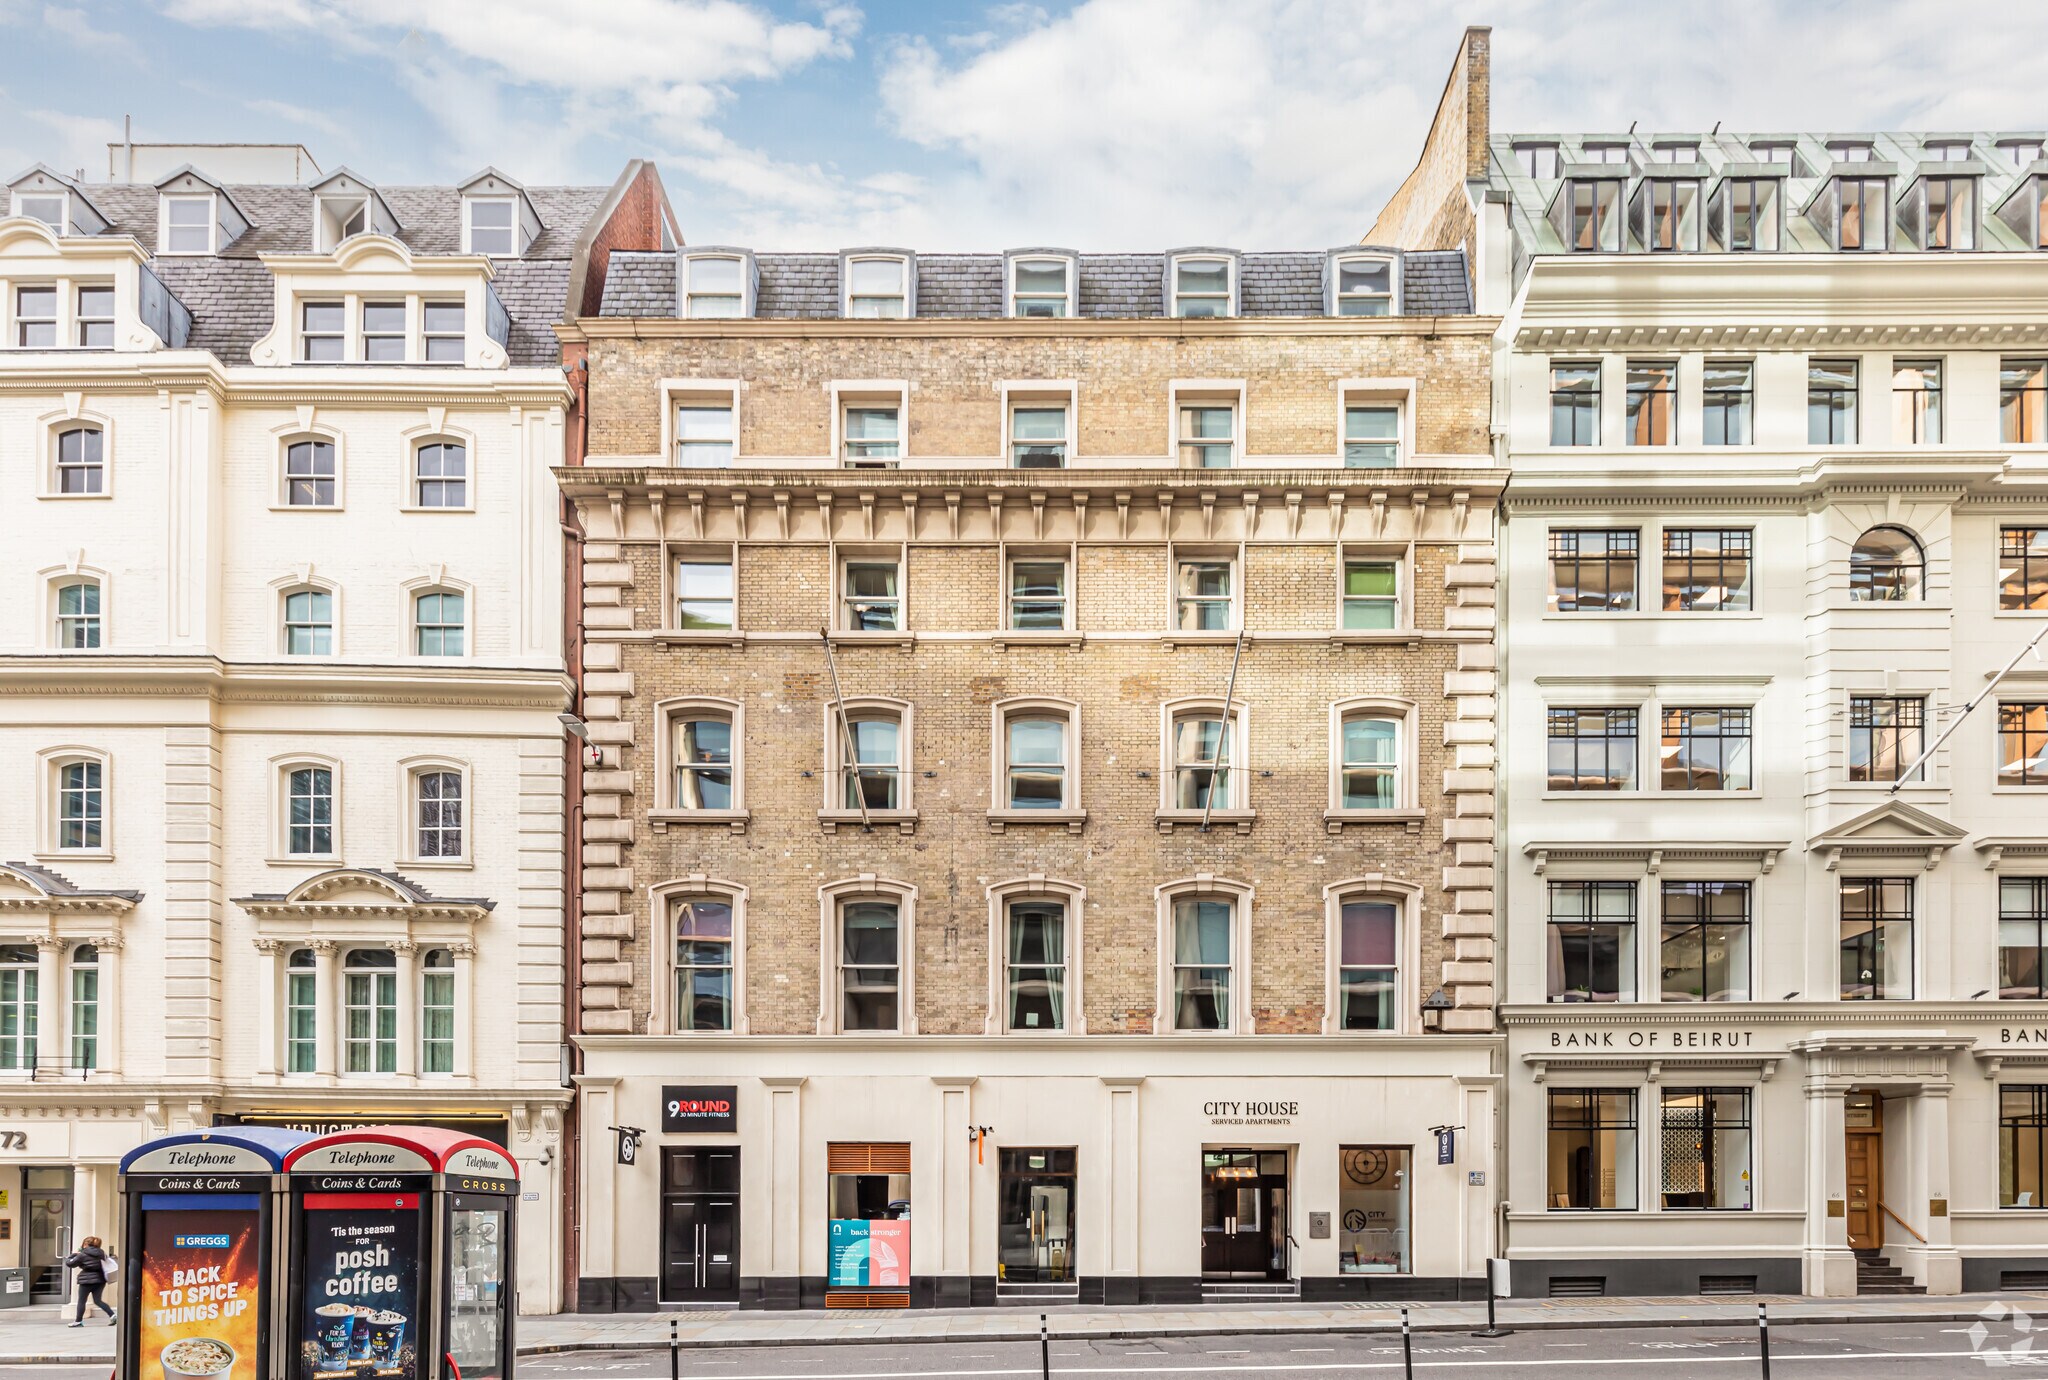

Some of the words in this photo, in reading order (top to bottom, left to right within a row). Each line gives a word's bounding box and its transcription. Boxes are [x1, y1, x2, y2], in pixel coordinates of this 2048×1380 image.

[1551, 1032, 1613, 1047] BANK
[1629, 1032, 1658, 1047] OF
[1673, 1032, 1752, 1047] BEIRUT
[2001, 1028, 2048, 1043] BAN
[1203, 1101, 1240, 1116] CITY
[1246, 1101, 1299, 1116] HOUSE
[0, 1131, 27, 1150] 72
[168, 1151, 236, 1167] Telephone
[329, 1151, 395, 1167] Telephone
[466, 1154, 500, 1170] Telephone
[159, 1178, 191, 1190] Coins
[192, 1178, 204, 1189] &
[206, 1178, 241, 1190] Cards
[322, 1178, 353, 1189] Coins
[355, 1178, 366, 1189] &
[368, 1177, 402, 1189] Cards
[463, 1179, 506, 1192] CROSS
[348, 1226, 362, 1236] the
[364, 1225, 395, 1235] season
[870, 1229, 901, 1237] stronger
[187, 1237, 227, 1245] GREGGS
[335, 1243, 389, 1275] posh
[173, 1265, 221, 1287] BACK
[159, 1289, 182, 1307] TO
[187, 1282, 238, 1304] SPICE
[153, 1303, 219, 1326] THINGS
[223, 1300, 248, 1317] UP
